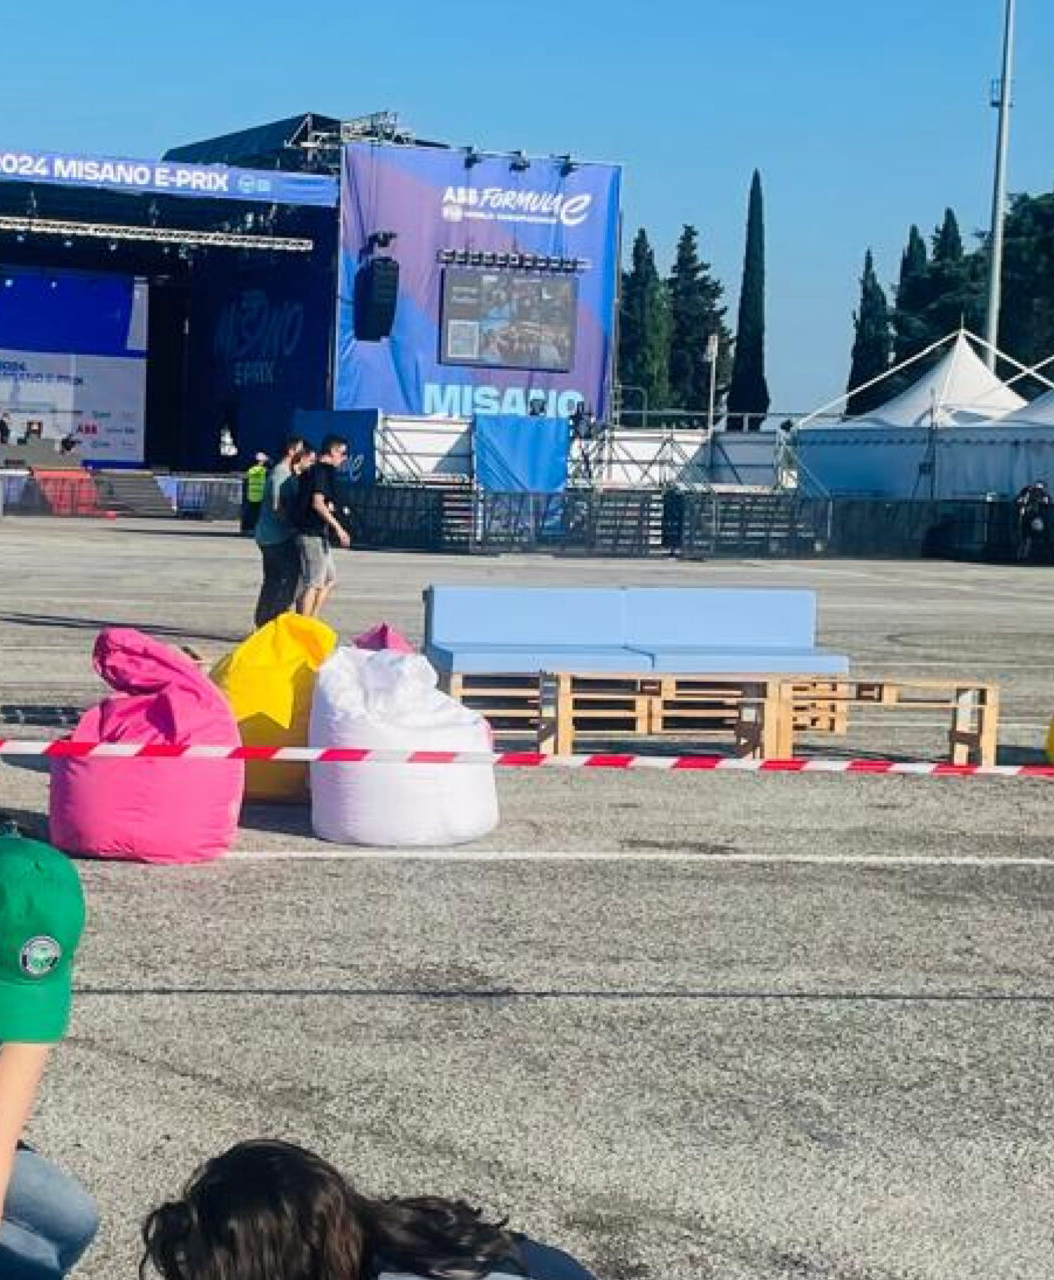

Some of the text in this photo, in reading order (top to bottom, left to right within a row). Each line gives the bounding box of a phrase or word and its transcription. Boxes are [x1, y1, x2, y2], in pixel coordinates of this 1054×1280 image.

[54, 158, 151, 185] MISANO
[154, 166, 229, 192] E-PRIX
[443, 186, 477, 205] ABB
